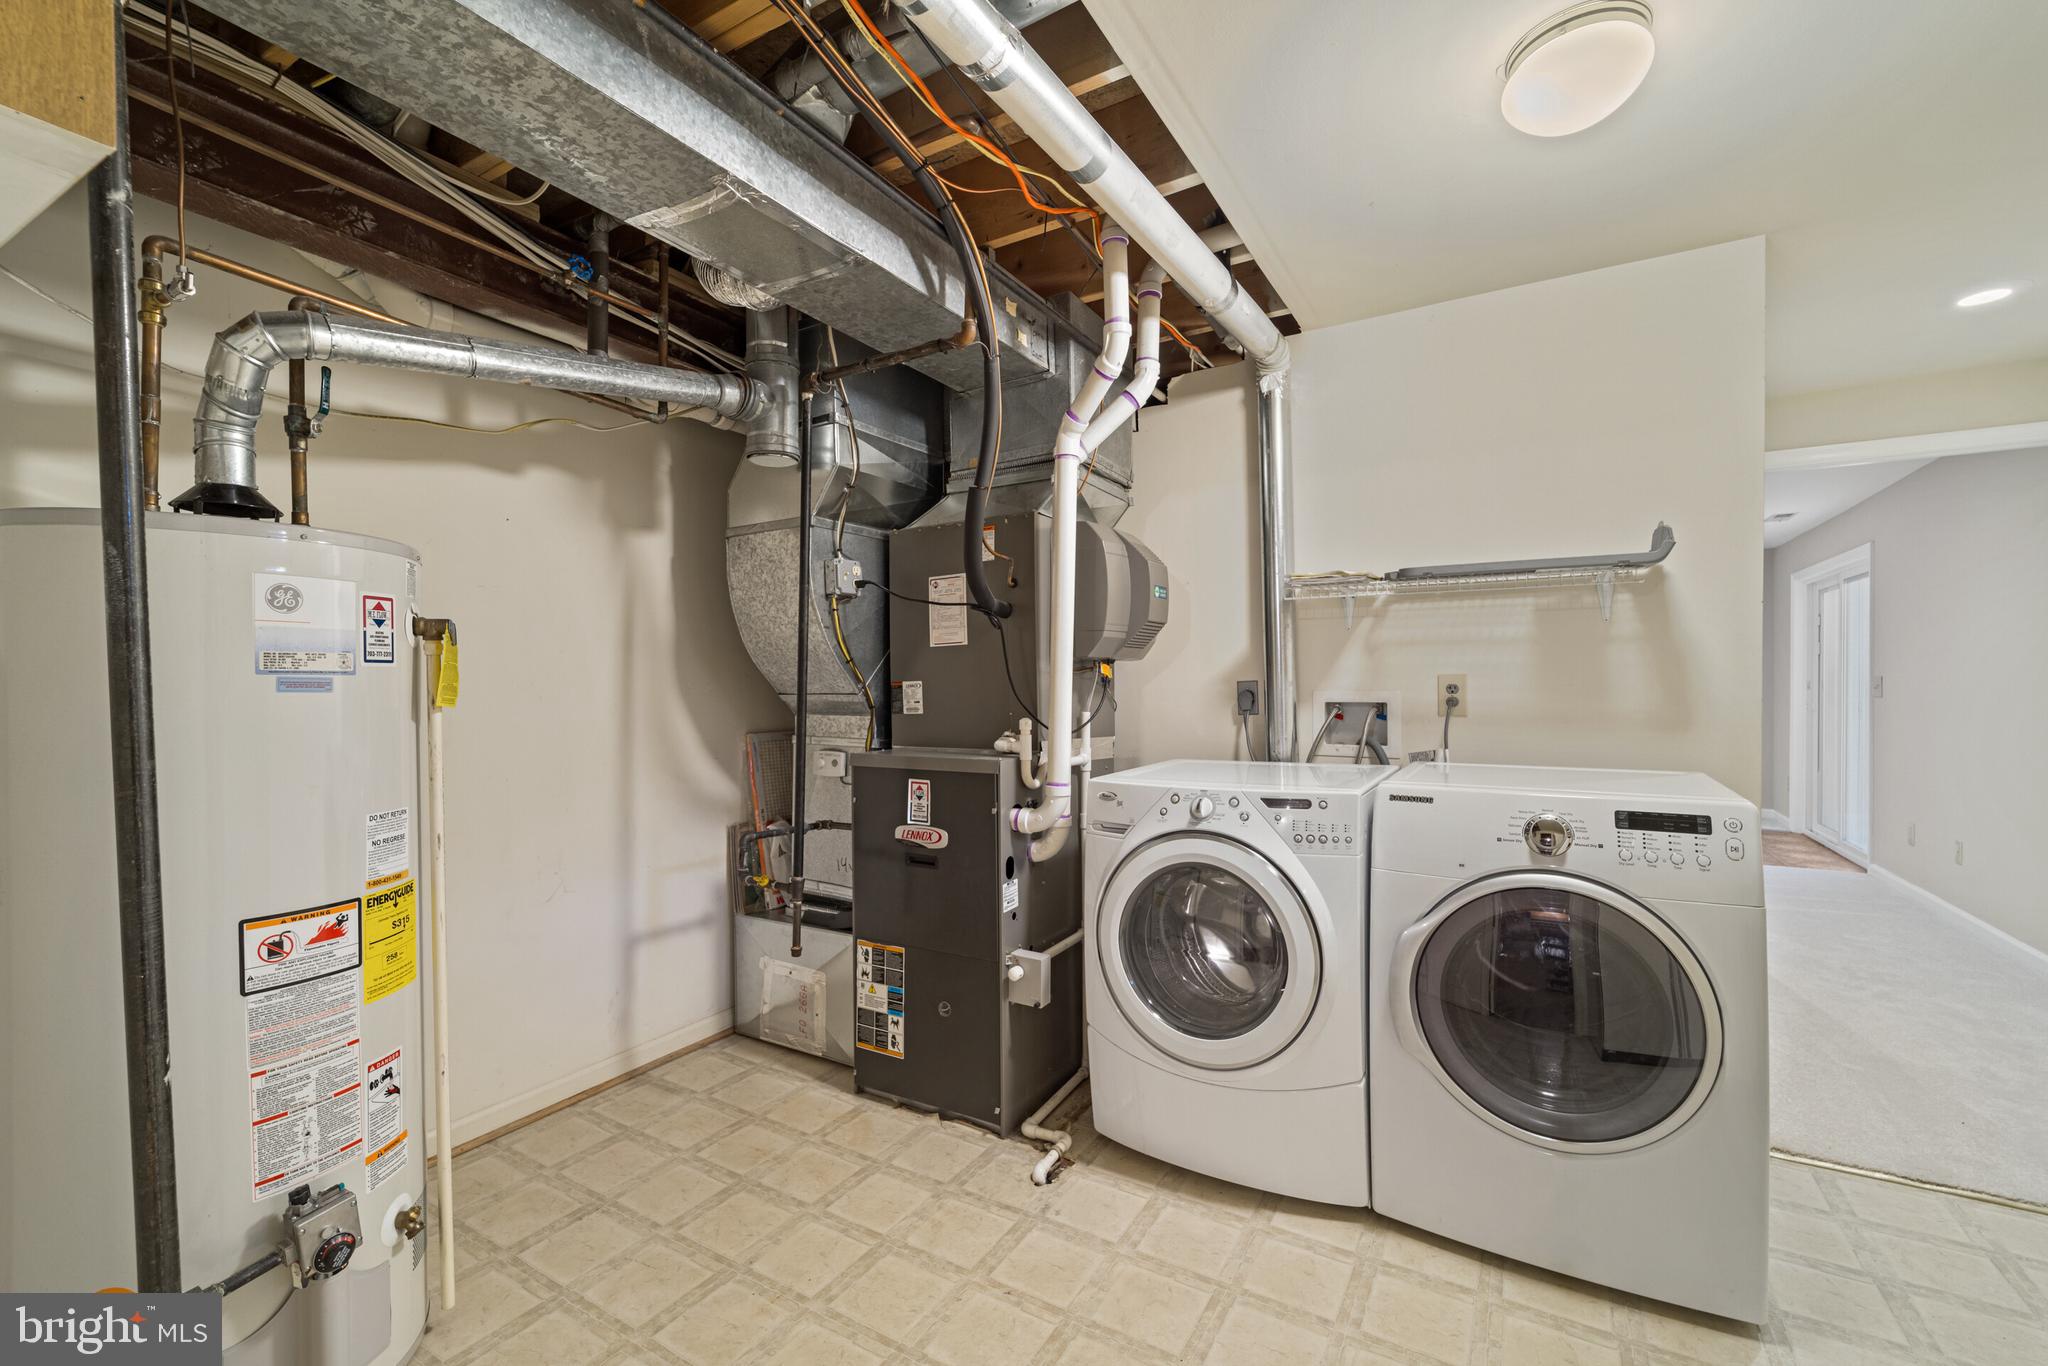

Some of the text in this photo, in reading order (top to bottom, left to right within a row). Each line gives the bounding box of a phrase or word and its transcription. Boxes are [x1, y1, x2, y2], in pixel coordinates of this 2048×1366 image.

[1389, 794, 1434, 804] SAMSUNG
[369, 809, 408, 822] DO NOT RETURN
[371, 833, 406, 847] NO REGRESE
[901, 829, 934, 842] LENNOX
[366, 882, 414, 909] ENERGYGUIDE
[290, 909, 332, 923] WARNING
[376, 1052, 400, 1068] DANGER
